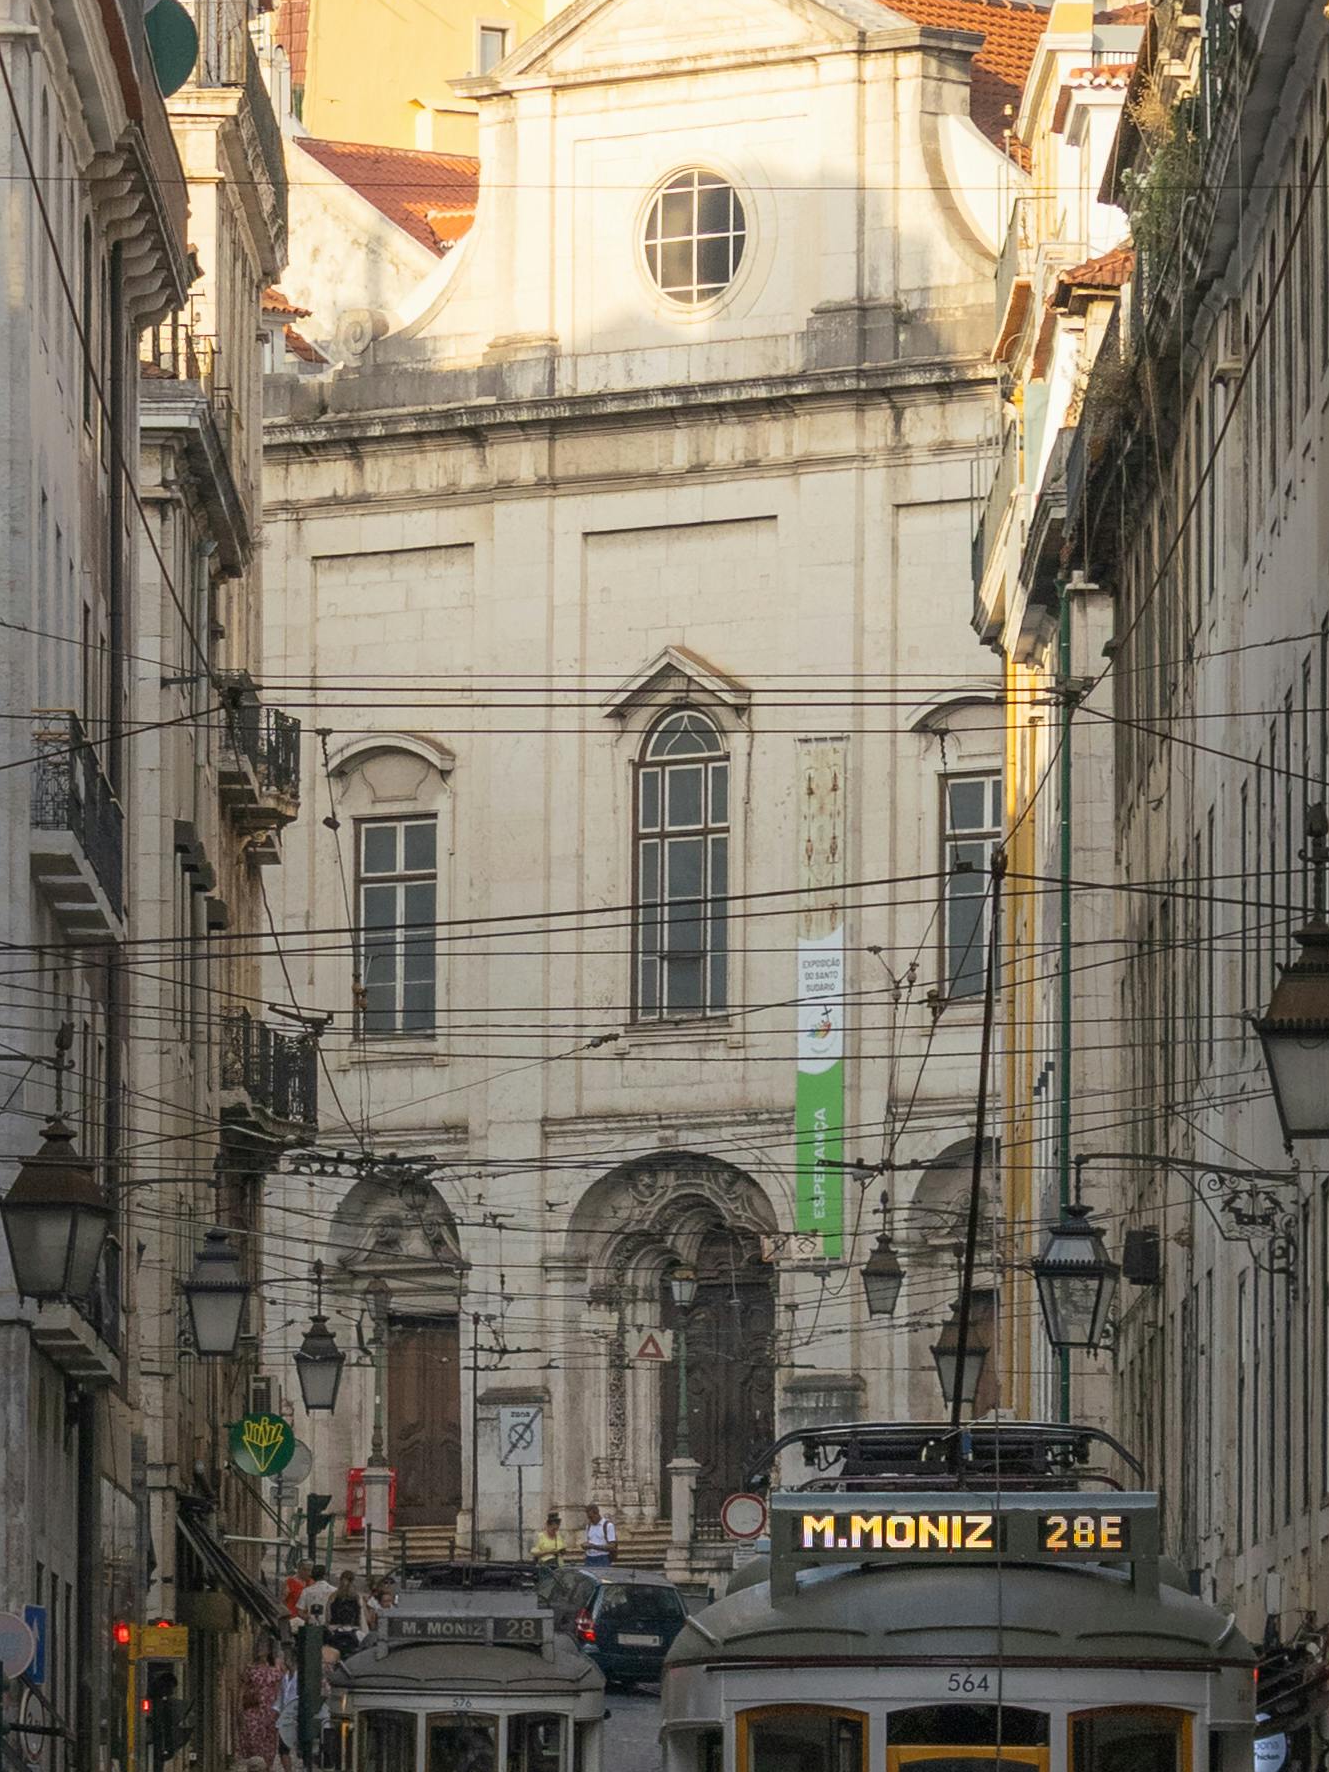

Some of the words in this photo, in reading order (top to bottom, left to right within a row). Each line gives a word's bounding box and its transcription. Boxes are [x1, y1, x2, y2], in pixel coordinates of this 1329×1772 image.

[815, 970, 839, 981] SANTO
[806, 981, 836, 992] SUDÁRIO
[813, 1105, 828, 1221] ESPERANÇA
[1045, 1514, 1123, 1549] 28E
[402, 1621, 421, 1635] M.
[427, 1621, 484, 1635] MONIZ
[506, 1619, 536, 1638] 28
[947, 1672, 990, 1693] 564
[452, 1698, 473, 1708] 576
